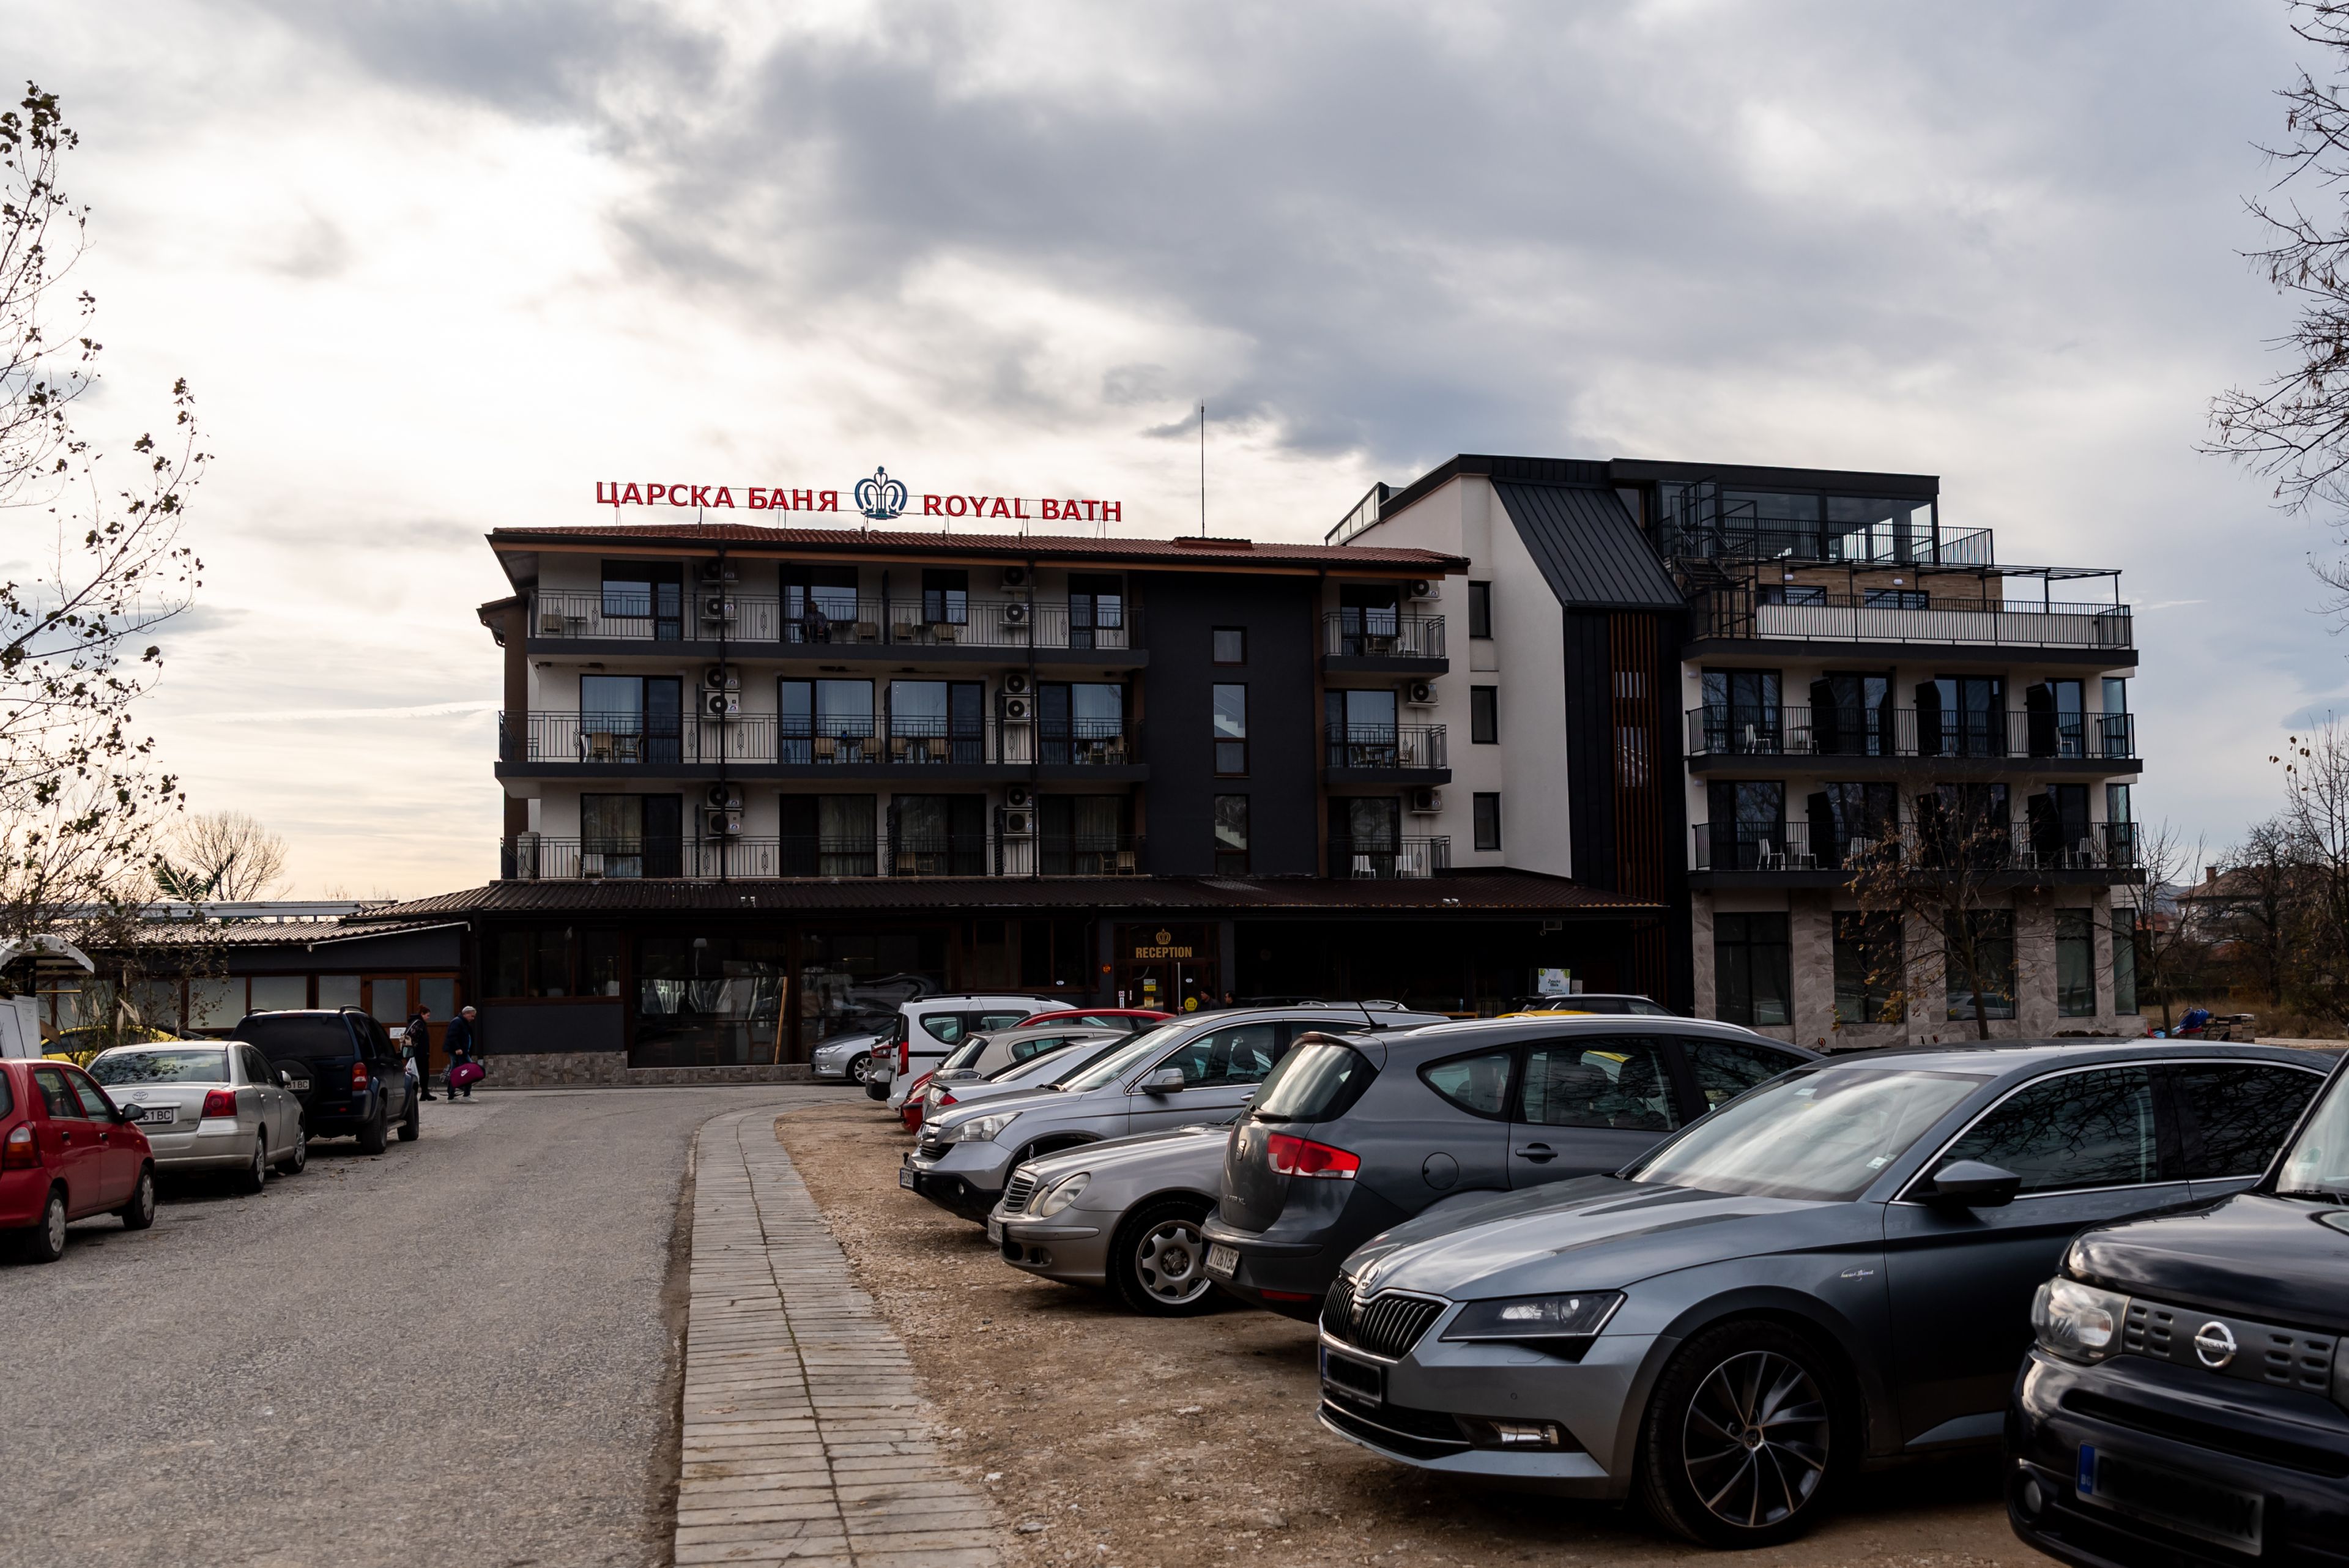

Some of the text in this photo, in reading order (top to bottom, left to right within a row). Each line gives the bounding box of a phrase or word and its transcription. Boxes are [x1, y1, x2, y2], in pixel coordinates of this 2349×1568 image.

[597, 481, 837, 512] ЦАРСКА БАНЯ
[924, 494, 1121, 522] ROYAL BATH
[1135, 946, 1192, 959] RECEPTION
[2197, 1339, 2229, 1352] NISSAN
[2080, 1473, 2092, 1487] BG
